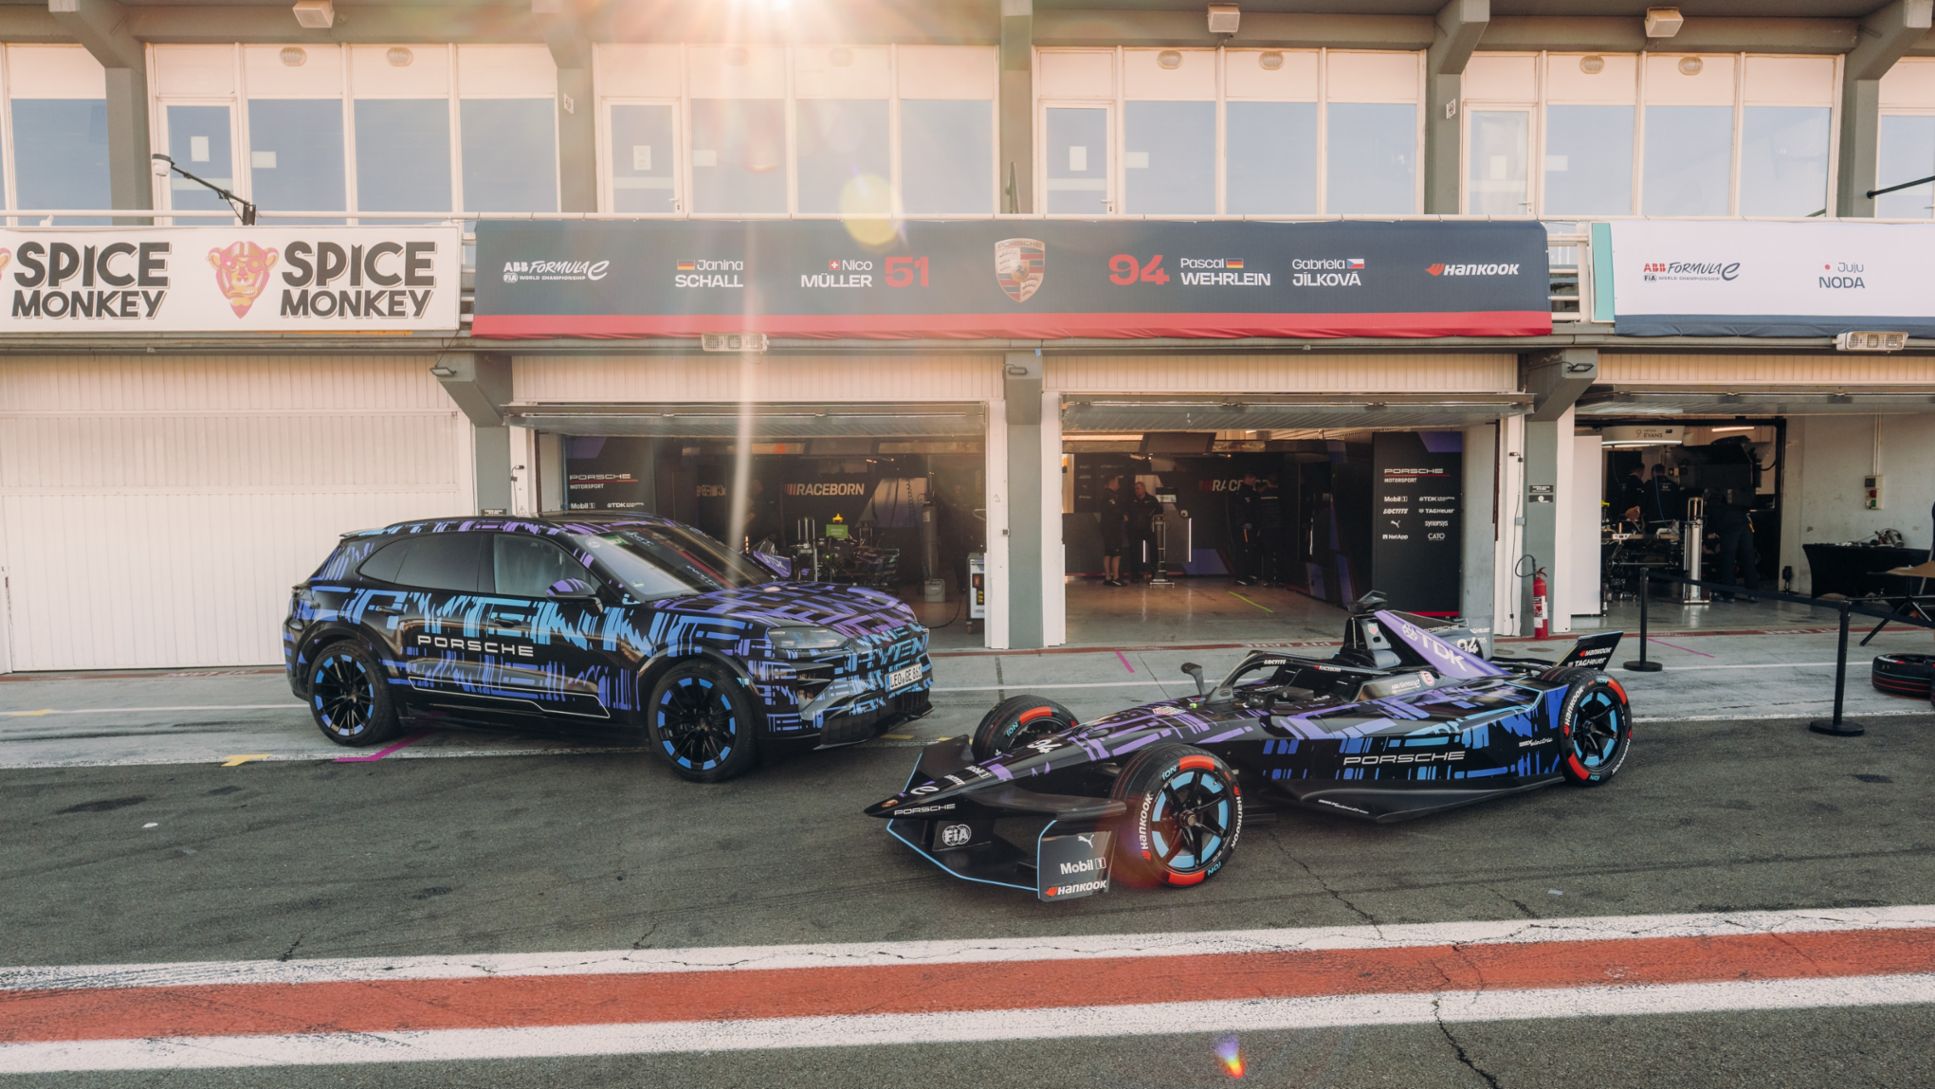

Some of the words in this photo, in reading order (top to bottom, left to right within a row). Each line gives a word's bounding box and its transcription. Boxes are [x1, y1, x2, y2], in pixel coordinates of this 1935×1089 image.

[14, 241, 170, 287] SPICE
[282, 241, 436, 287] SPICE
[503, 262, 528, 272] ABB
[529, 261, 590, 274] FORMULA
[697, 259, 743, 270] Janina
[842, 260, 872, 270] Nico
[1108, 255, 1170, 286] 94
[1181, 258, 1224, 269] Pascal
[1292, 259, 1345, 270] Gabriela
[1644, 263, 1666, 272] ABB
[1668, 262, 1722, 274] FORMULA
[1837, 262, 1864, 273] Juju
[884, 256, 929, 288] 51
[1181, 272, 1271, 286] WEHRLEIN
[1292, 271, 1361, 286] JÍLKOVÁ
[675, 275, 743, 287] SCHALL
[801, 272, 872, 287] MÜLLER
[1819, 276, 1865, 289] NODA
[12, 290, 166, 318] MONKEY
[280, 289, 433, 318] MONKEY
[796, 483, 865, 496] RACEBORN
[570, 502, 589, 510] Mobil
[417, 635, 534, 657] PORSCHE
[1415, 627, 1468, 672] TDK
[1343, 751, 1466, 765] PORSCHE
[894, 803, 956, 816] PORSCHE
[1060, 859, 1094, 875] Mobil
